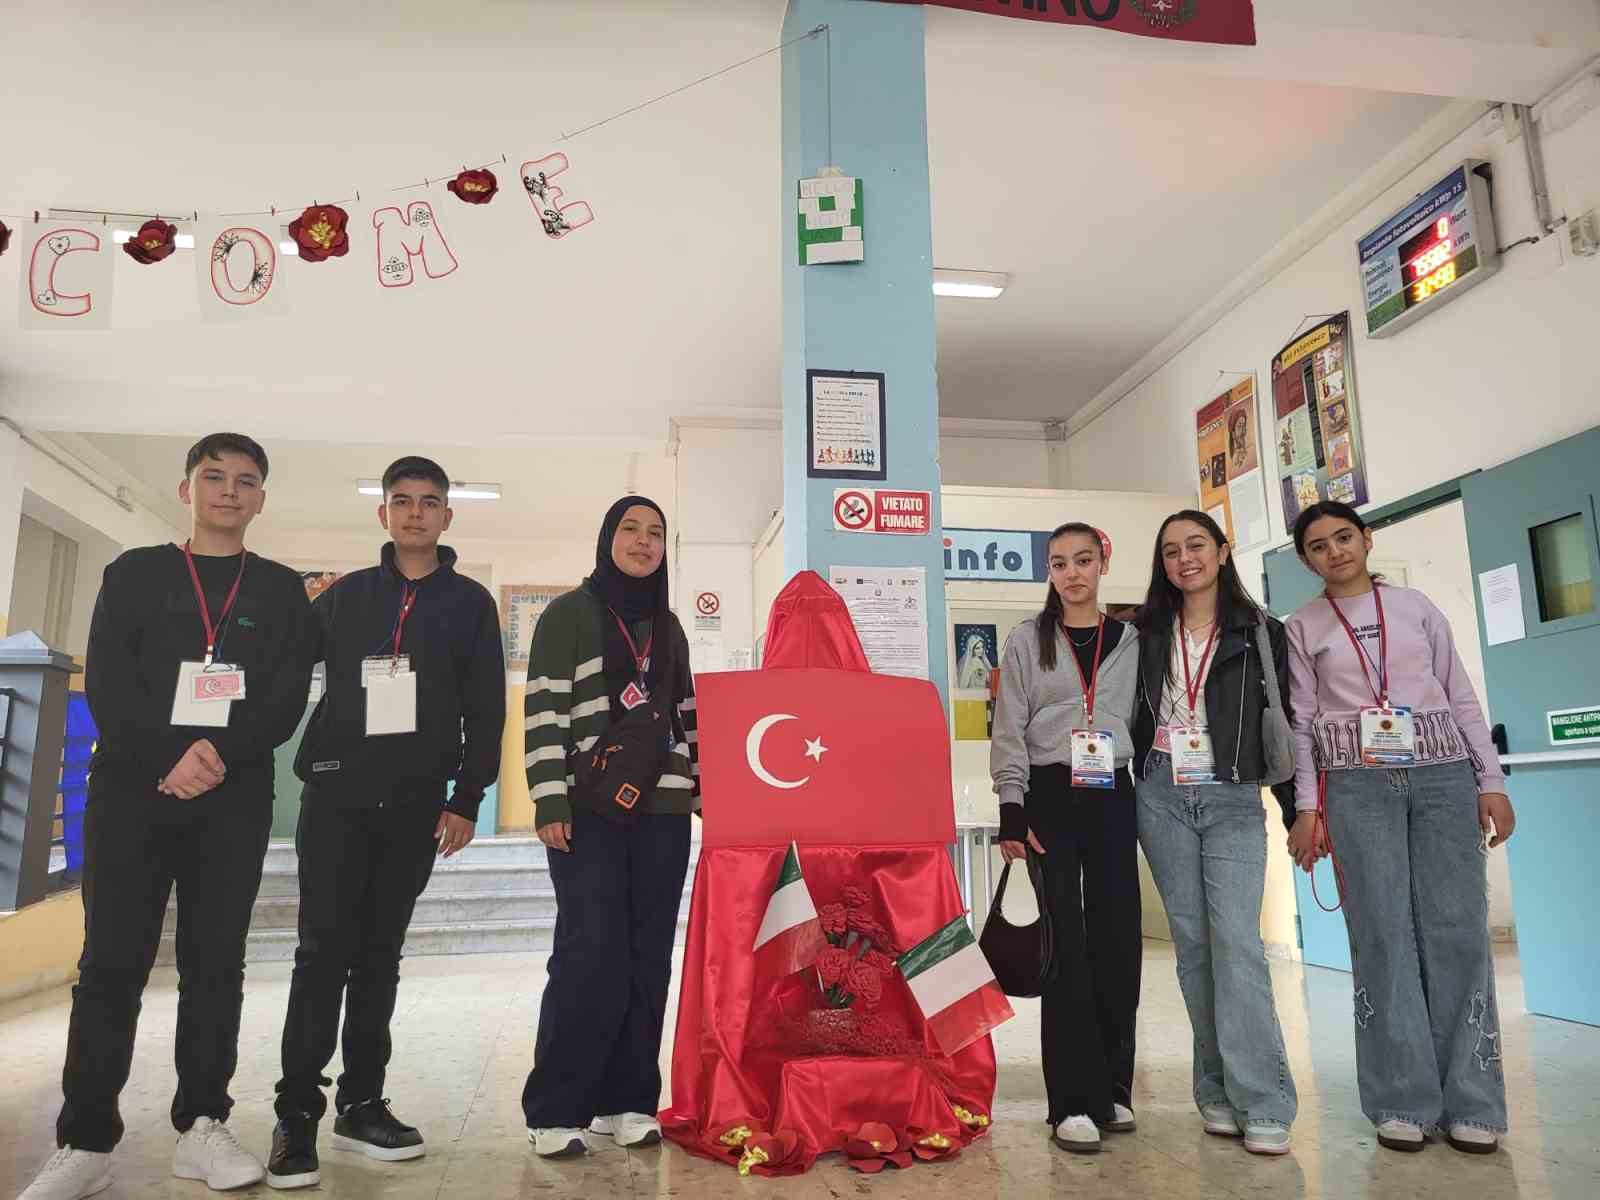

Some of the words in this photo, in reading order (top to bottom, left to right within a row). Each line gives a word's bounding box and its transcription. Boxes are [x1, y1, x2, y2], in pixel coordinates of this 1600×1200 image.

[882, 496, 923, 511] VIETATO
[880, 513, 925, 529] FUMARE
[943, 538, 1023, 571] info
